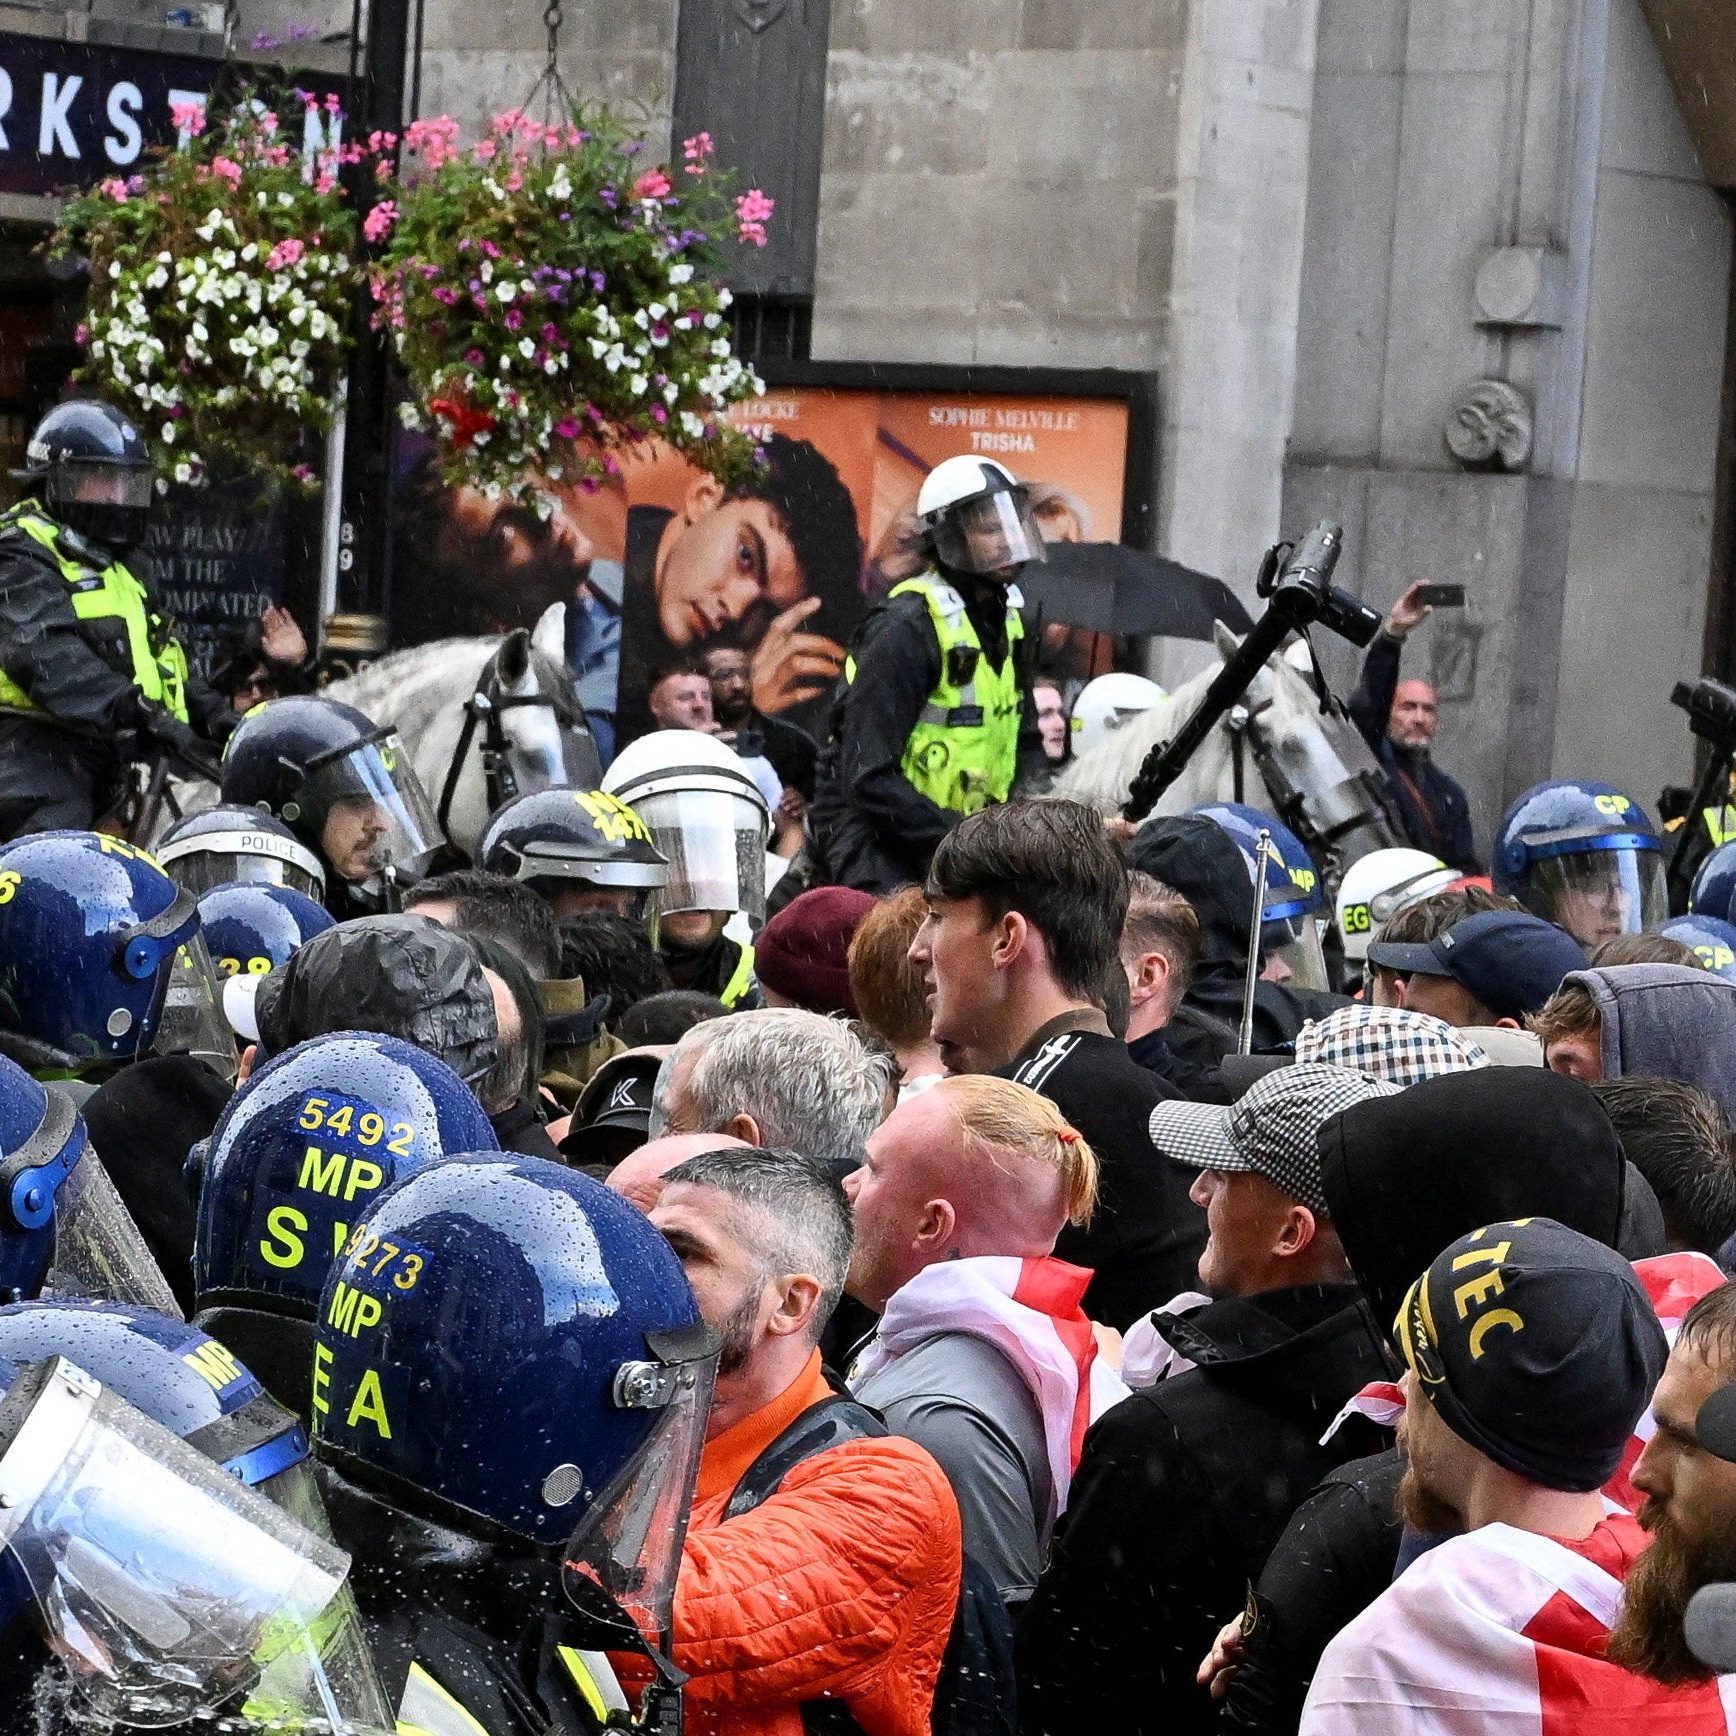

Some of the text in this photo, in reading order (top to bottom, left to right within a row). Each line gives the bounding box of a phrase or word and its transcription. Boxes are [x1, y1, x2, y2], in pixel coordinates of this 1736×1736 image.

[928, 405, 990, 427] SOPHIE
[970, 431, 1037, 453] TRISHA
[1594, 794, 1630, 815] CP
[239, 836, 297, 861] POLICE
[1343, 905, 1369, 932] EG
[299, 1098, 416, 1158] 5492
[297, 1147, 384, 1203] MP
[327, 1280, 382, 1340] MP
[182, 1340, 243, 1392] MP
